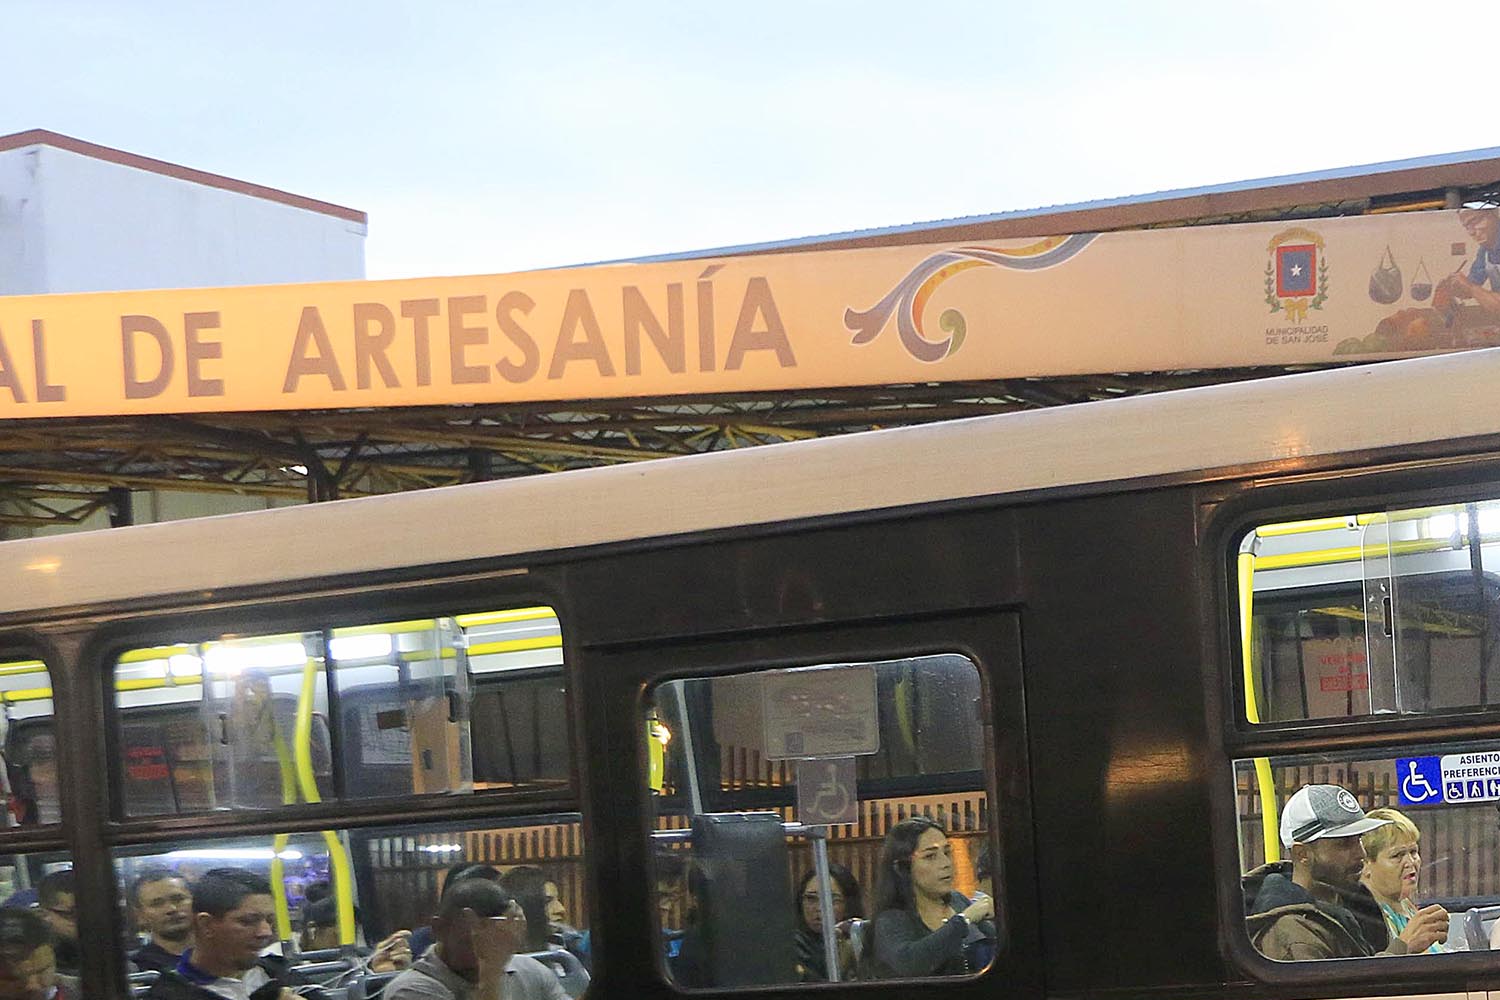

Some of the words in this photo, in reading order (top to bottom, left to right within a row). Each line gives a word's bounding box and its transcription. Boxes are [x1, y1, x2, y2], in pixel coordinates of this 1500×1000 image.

[120, 311, 225, 400] DE
[282, 264, 797, 395] ARTESANÍA
[1265, 325, 1329, 337] MUNICIPALIDAD
[1266, 336, 1280, 345] DE
[1281, 334, 1302, 345] SAN
